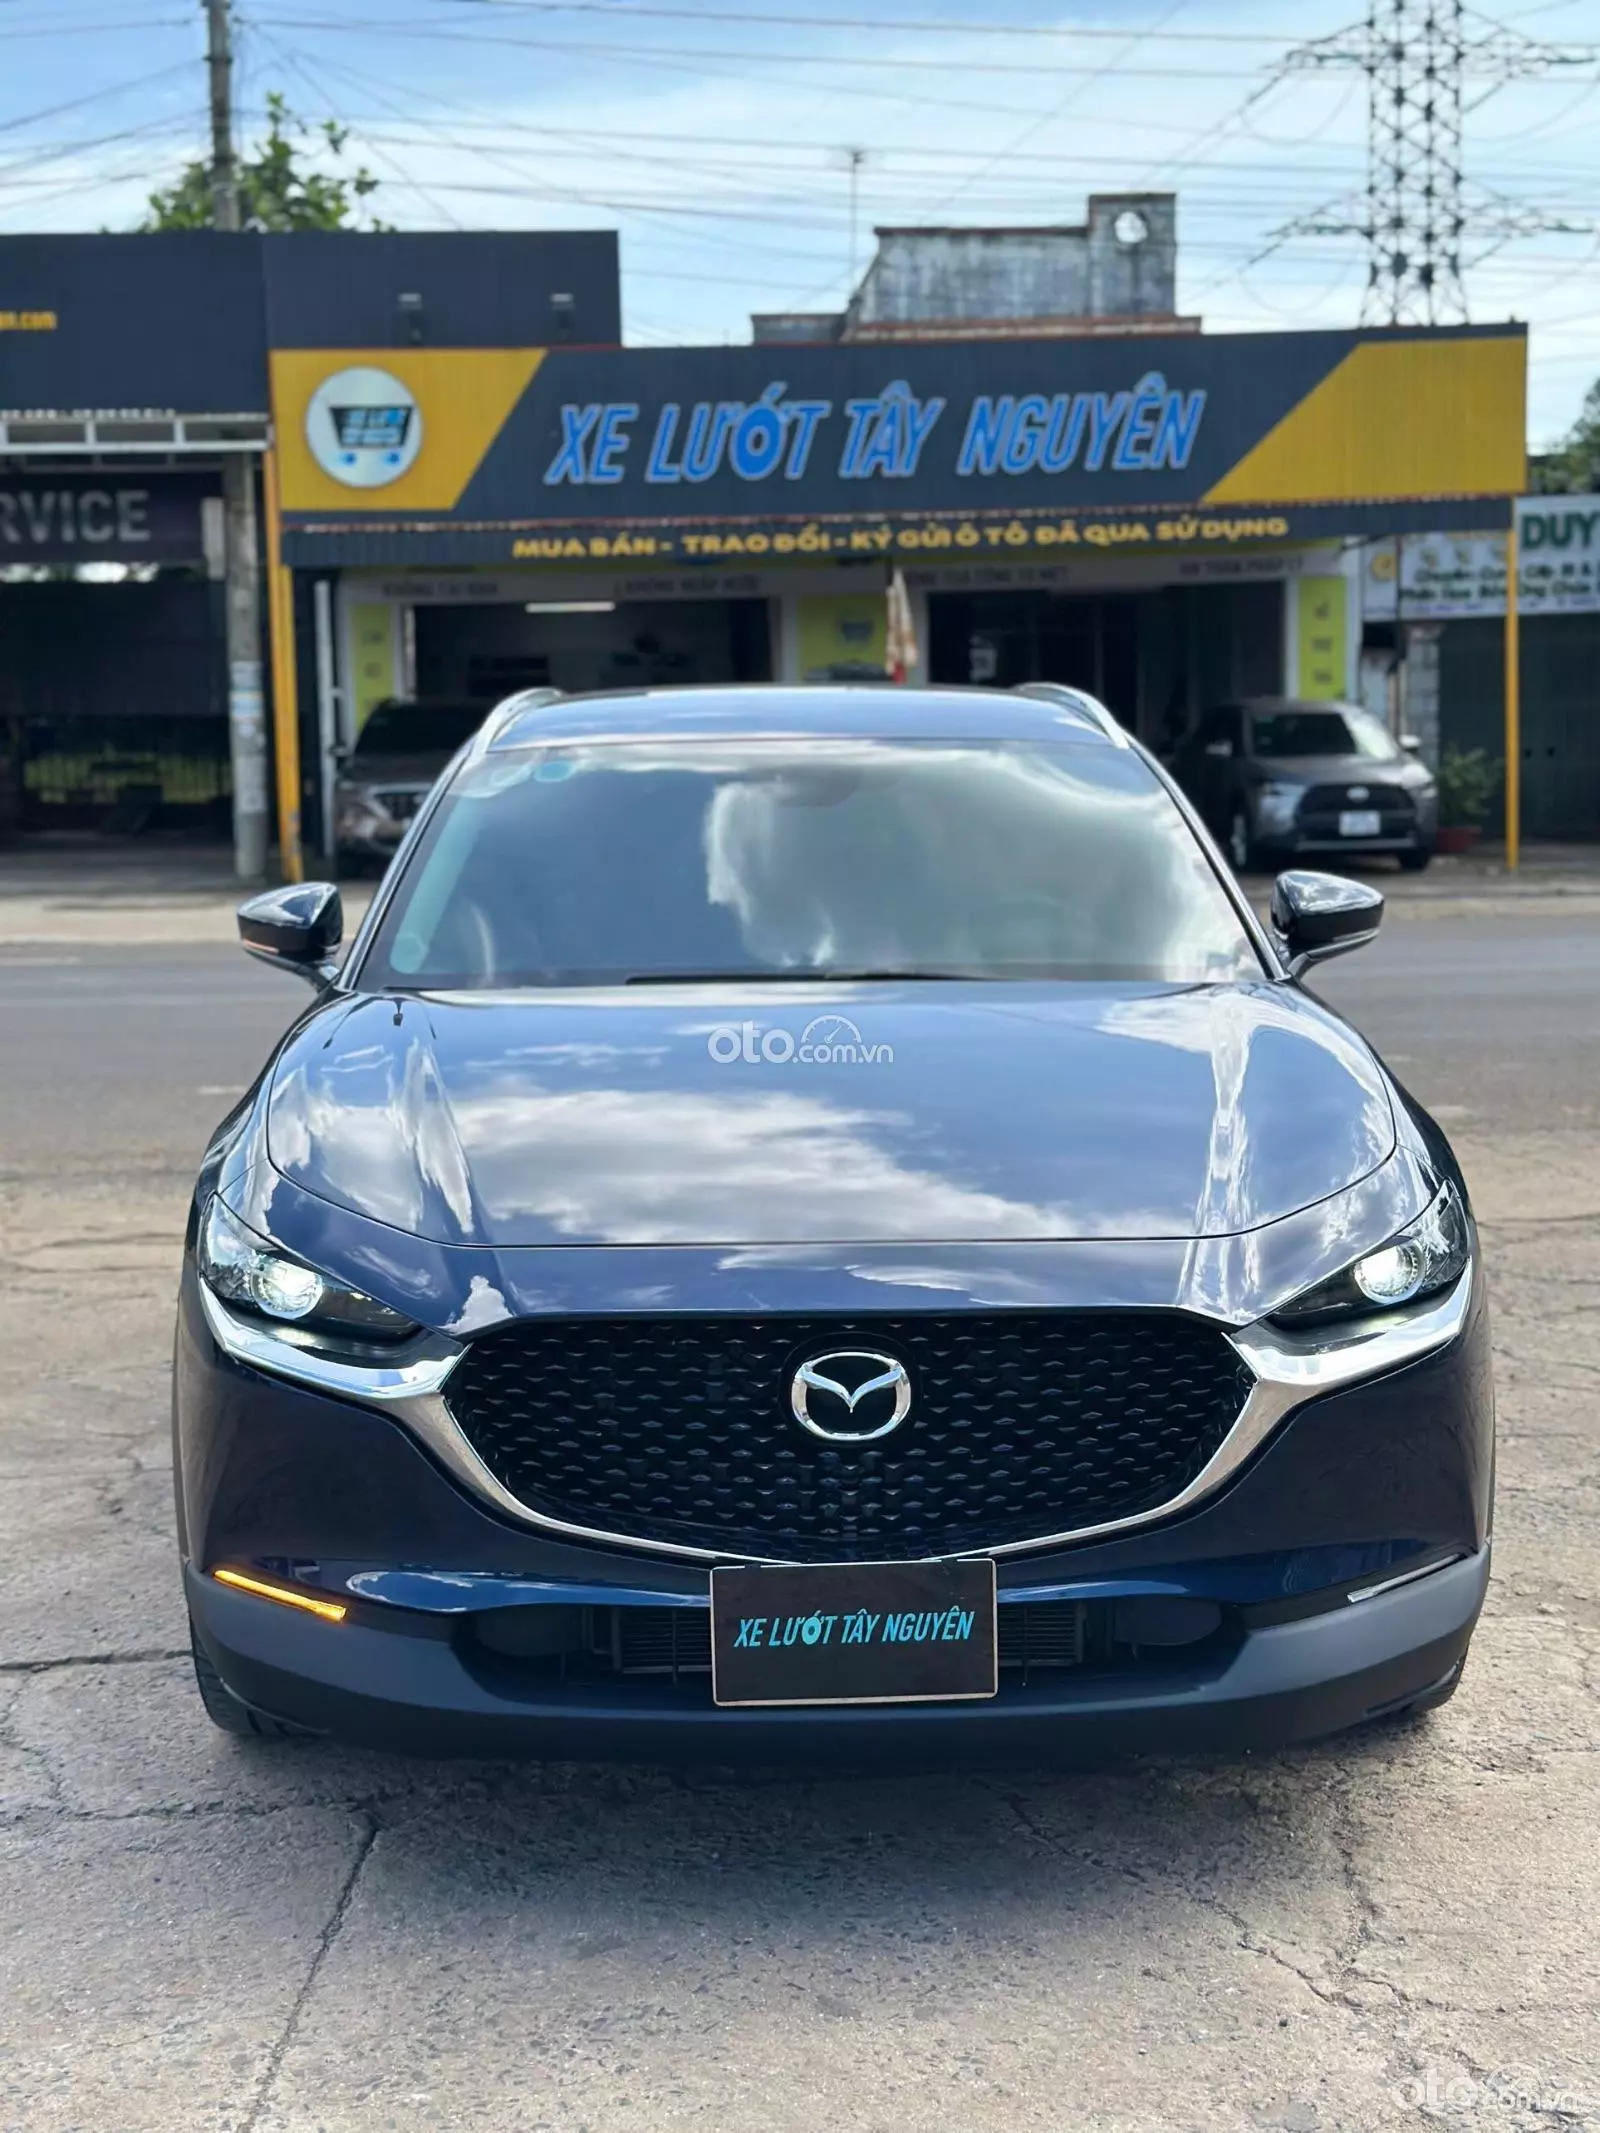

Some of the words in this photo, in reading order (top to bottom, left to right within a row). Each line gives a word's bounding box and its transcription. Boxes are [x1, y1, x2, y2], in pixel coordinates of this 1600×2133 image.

[543, 403, 639, 485] XE
[645, 381, 831, 482] LƯỚT
[839, 379, 946, 479] TÂY
[956, 371, 1207, 476] NGUYÊN
[512, 537, 587, 558] MUA
[588, 531, 657, 557] BÁN
[681, 534, 770, 555] TRAO
[851, 524, 893, 550] KÝ
[954, 521, 981, 547] Ô
[984, 520, 1029, 546] TÔ
[1082, 522, 1150, 547] QUA
[1200, 517, 1289, 543] DỤNG
[734, 1618, 767, 1647] XE
[768, 1610, 838, 1646] LƯỚT
[841, 1608, 880, 1643] TÂY
[881, 1605, 975, 1641] NGUYÊN
